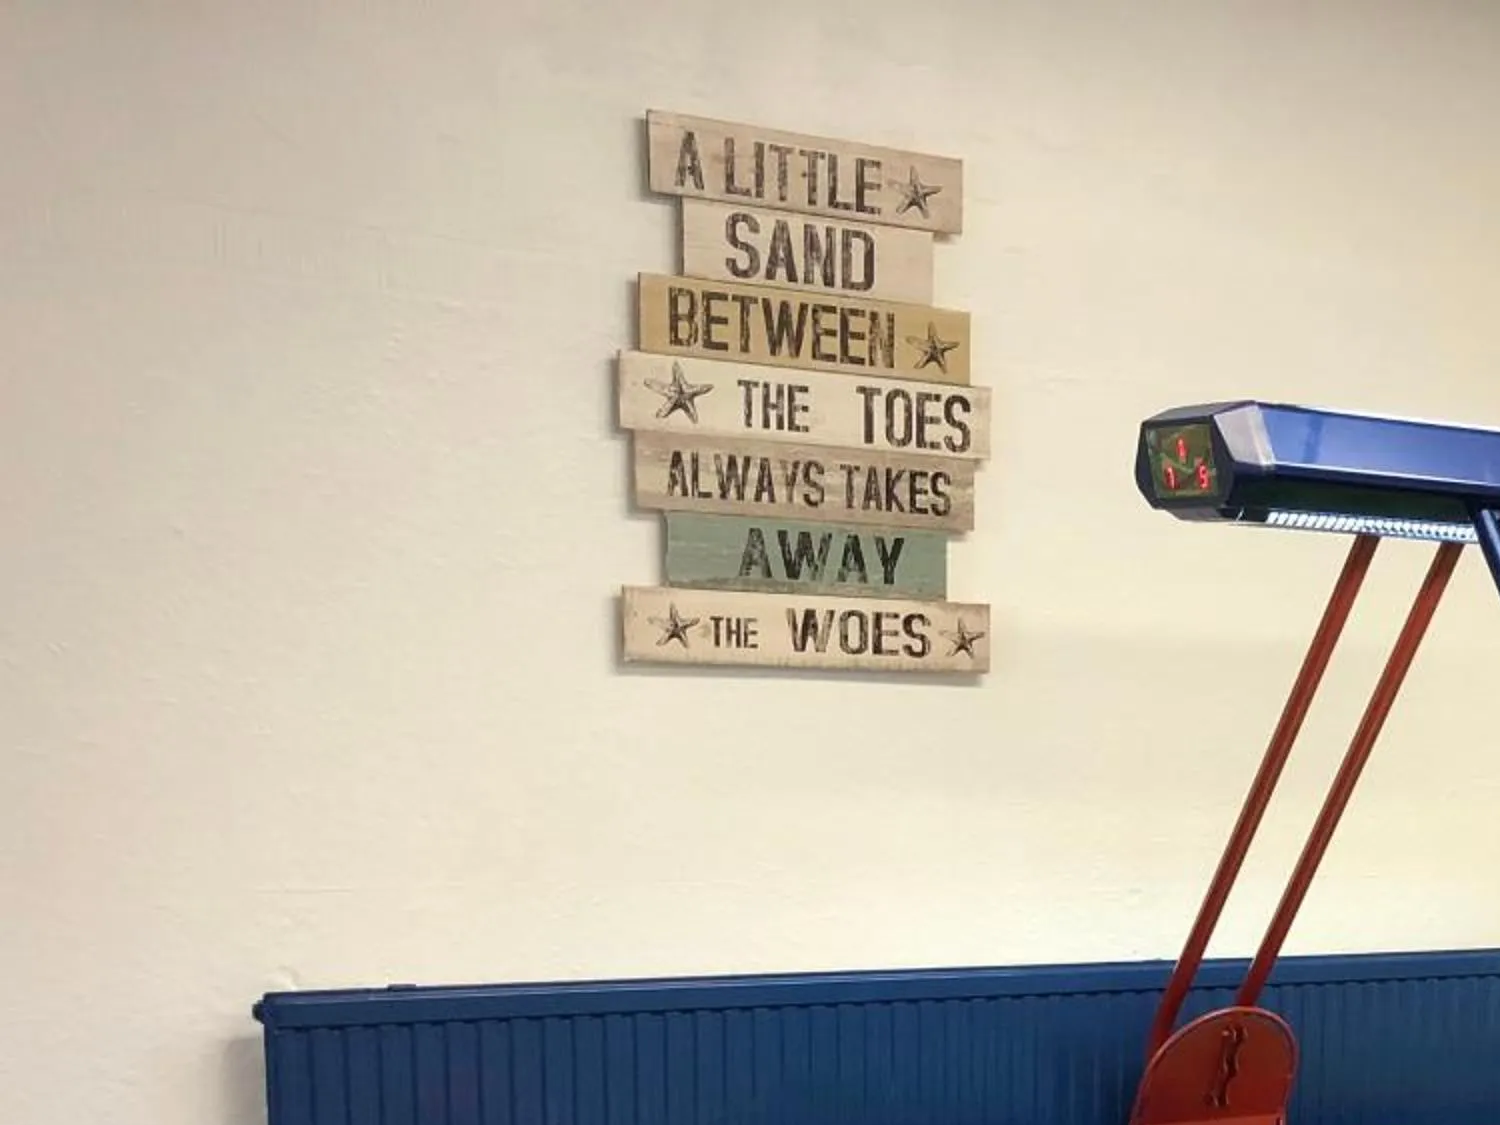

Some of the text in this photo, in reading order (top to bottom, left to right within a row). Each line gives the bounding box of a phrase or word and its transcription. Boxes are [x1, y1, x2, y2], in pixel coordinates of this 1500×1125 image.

[675, 131, 882, 215] A LITTLE
[725, 212, 875, 292] SAND
[667, 286, 896, 369] BETWEEN
[737, 379, 972, 453] THE TOES
[667, 450, 952, 517] ALWAYS TAKES
[738, 527, 905, 585] AWAY
[710, 607, 932, 658] THE WOES
